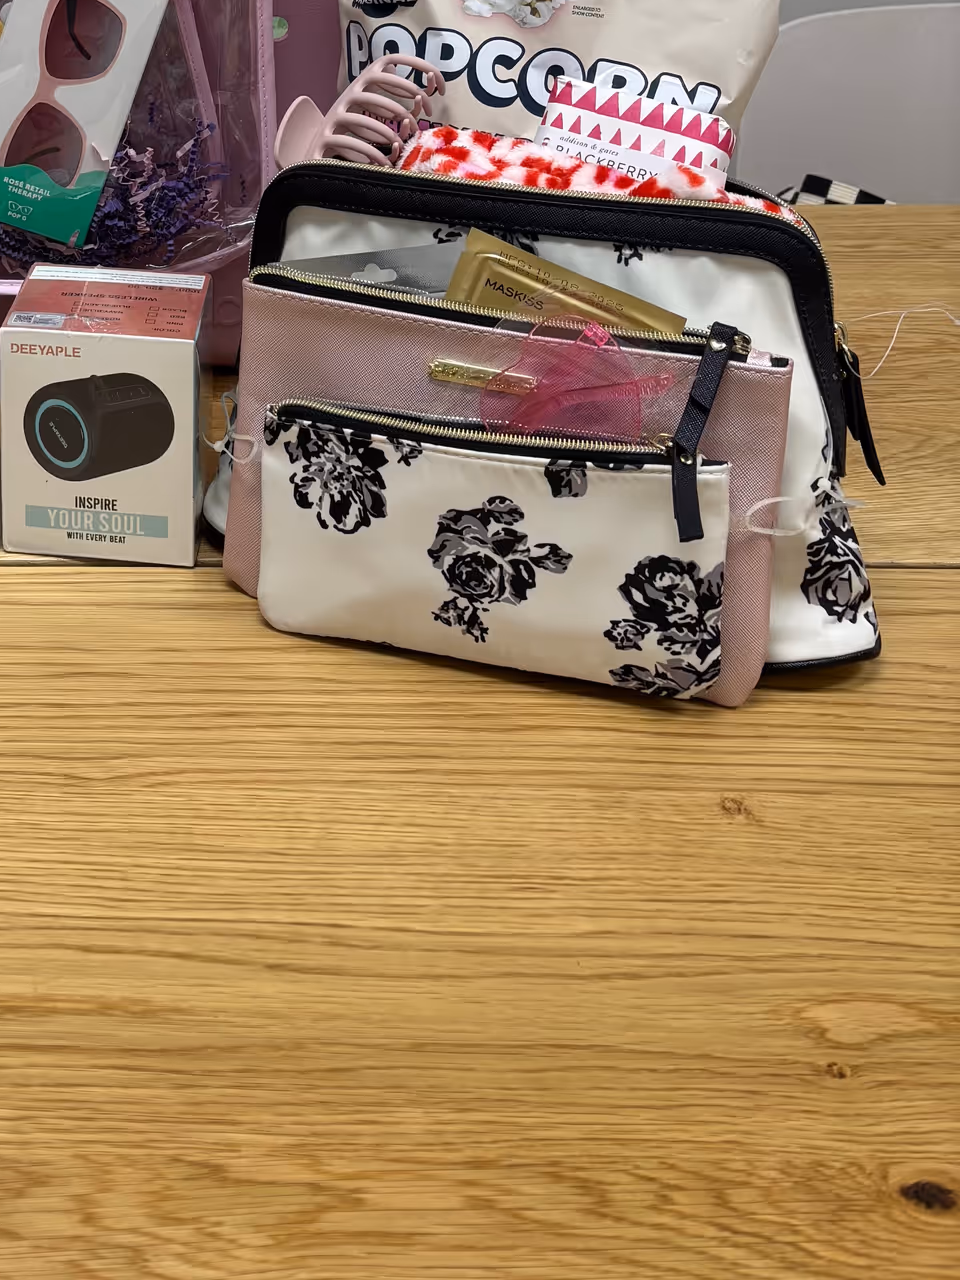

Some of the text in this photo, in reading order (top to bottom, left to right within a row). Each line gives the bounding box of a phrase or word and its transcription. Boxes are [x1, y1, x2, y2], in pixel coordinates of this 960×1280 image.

[559, 136, 588, 148] addison
[599, 147, 620, 157] gates
[3, 176, 51, 197] ROSÉ RETAIL
[7, 184, 44, 201] THERAPY
[7, 210, 21, 219] POP
[60, 291, 107, 300] SPEAKER
[484, 277, 545, 311] MASKISS
[10, 342, 82, 359] DEEYAPLE
[74, 495, 118, 512] INSPIRE
[47, 508, 145, 535] YOUR SOUL
[66, 530, 126, 544] WITH EVERY BEAT
